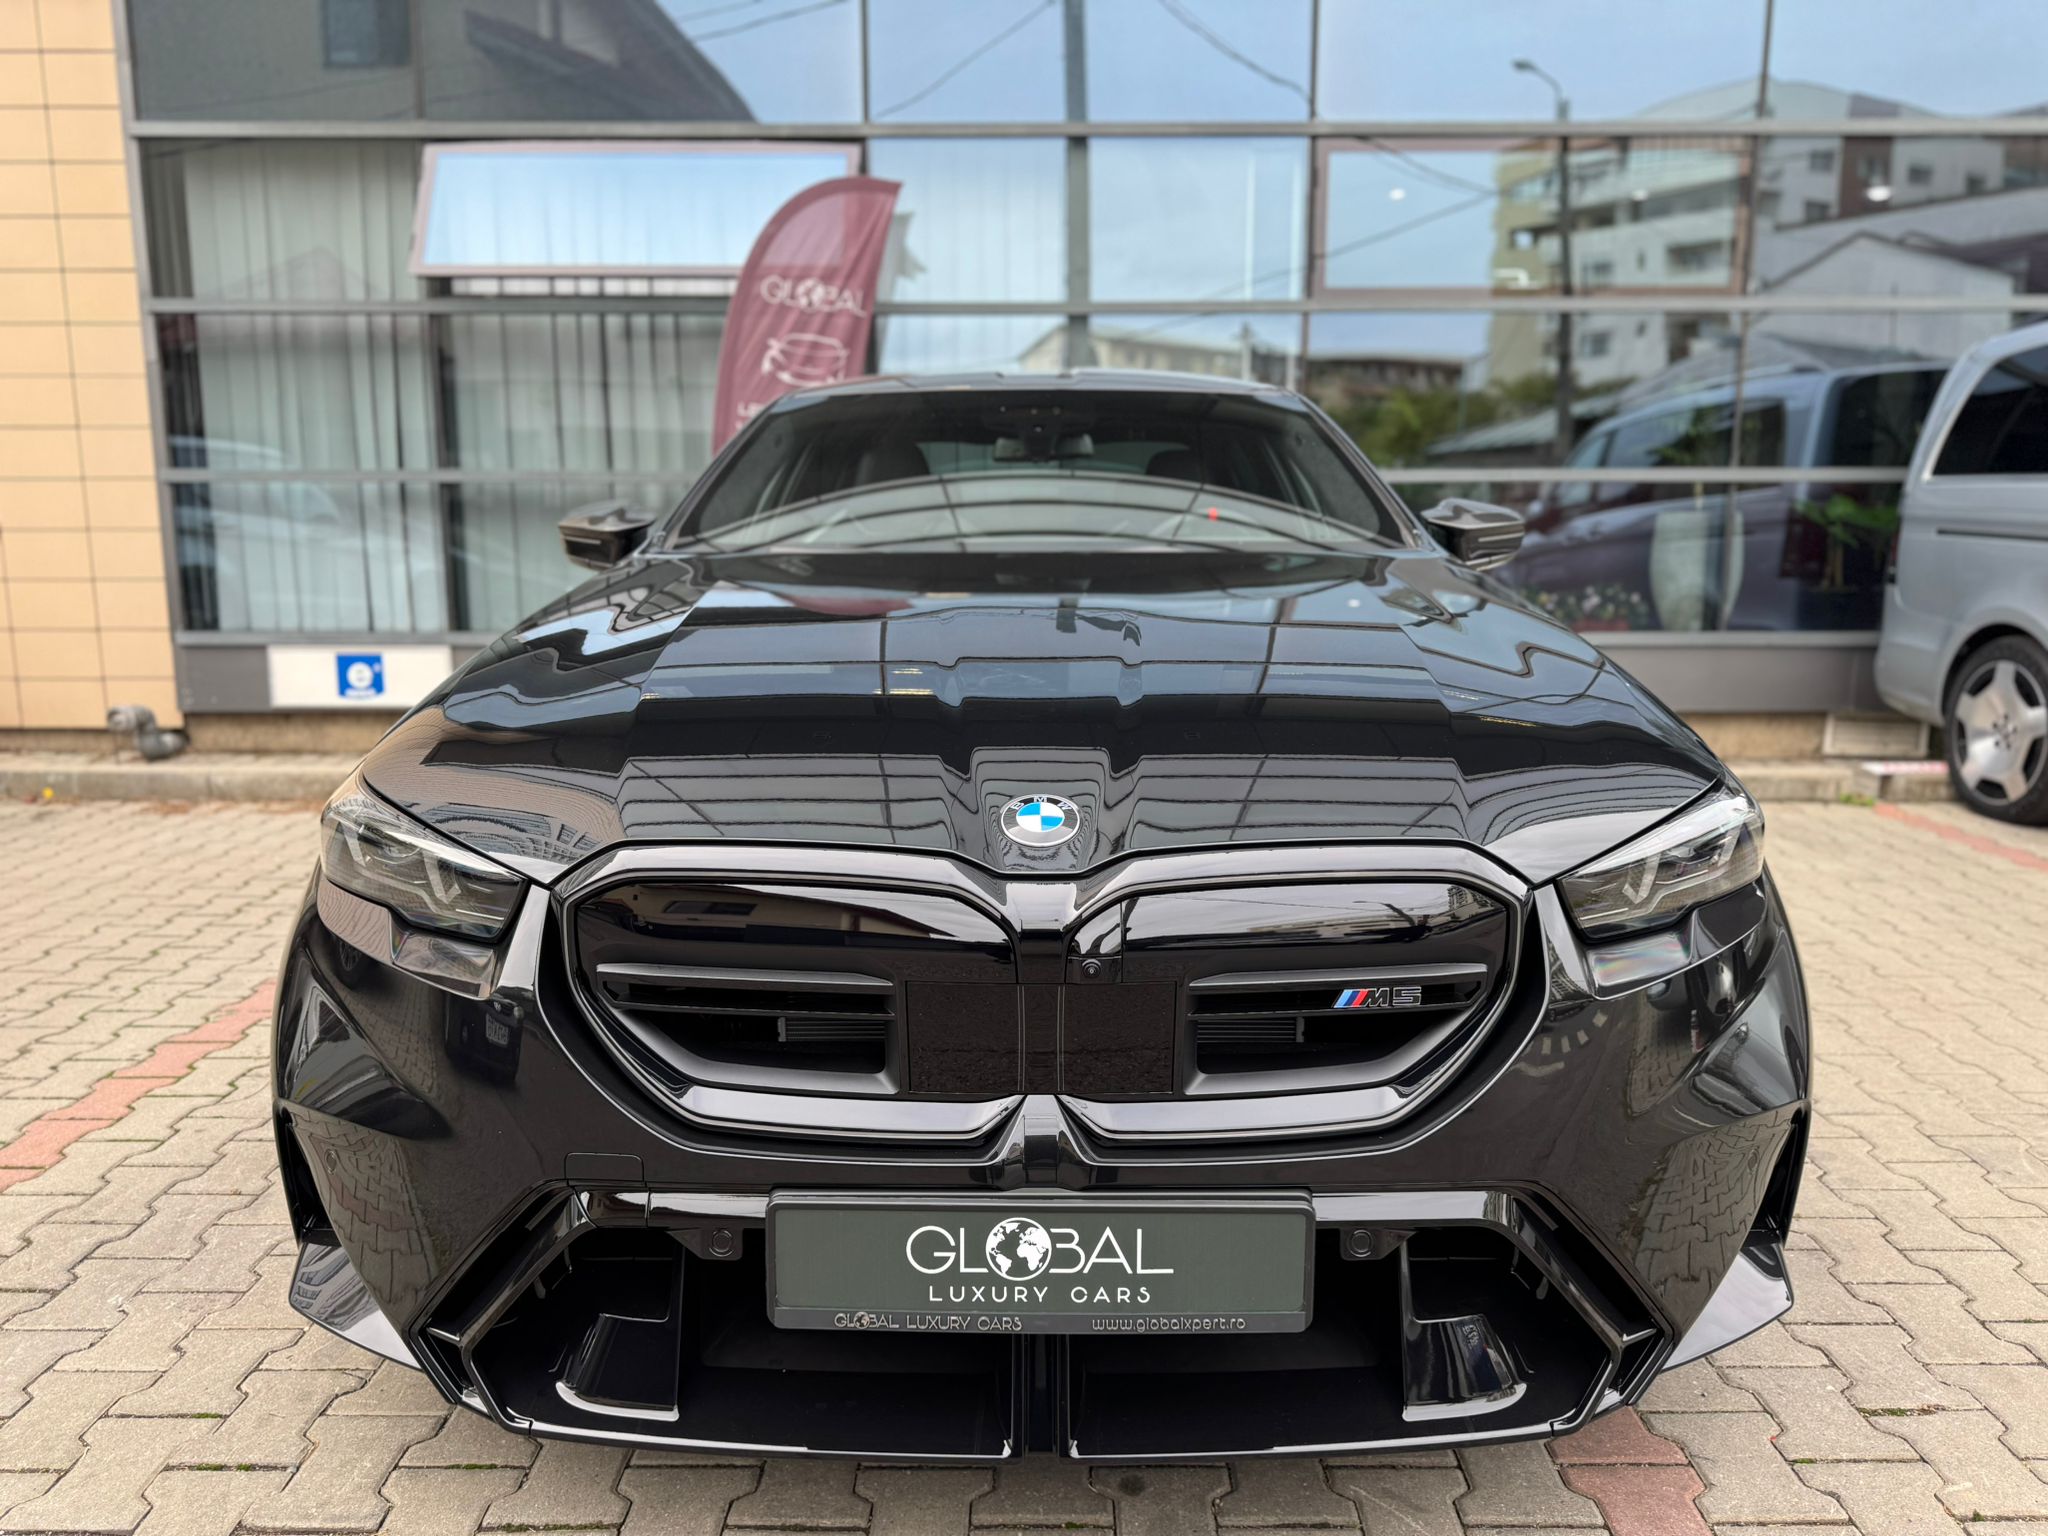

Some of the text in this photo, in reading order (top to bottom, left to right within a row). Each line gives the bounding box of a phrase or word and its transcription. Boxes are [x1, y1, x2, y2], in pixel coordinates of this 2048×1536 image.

[760, 274, 867, 319] GLOBAL
[1009, 795, 1072, 811] BMW
[1359, 986, 1422, 1007] M5
[905, 1216, 1174, 1282] GLOBAL
[928, 1285, 1151, 1304] LUXURY CARS
[834, 1311, 1023, 1332] GLOBAL LUXURY CARS
[1091, 1317, 1247, 1332] www.globalxpert.ro
